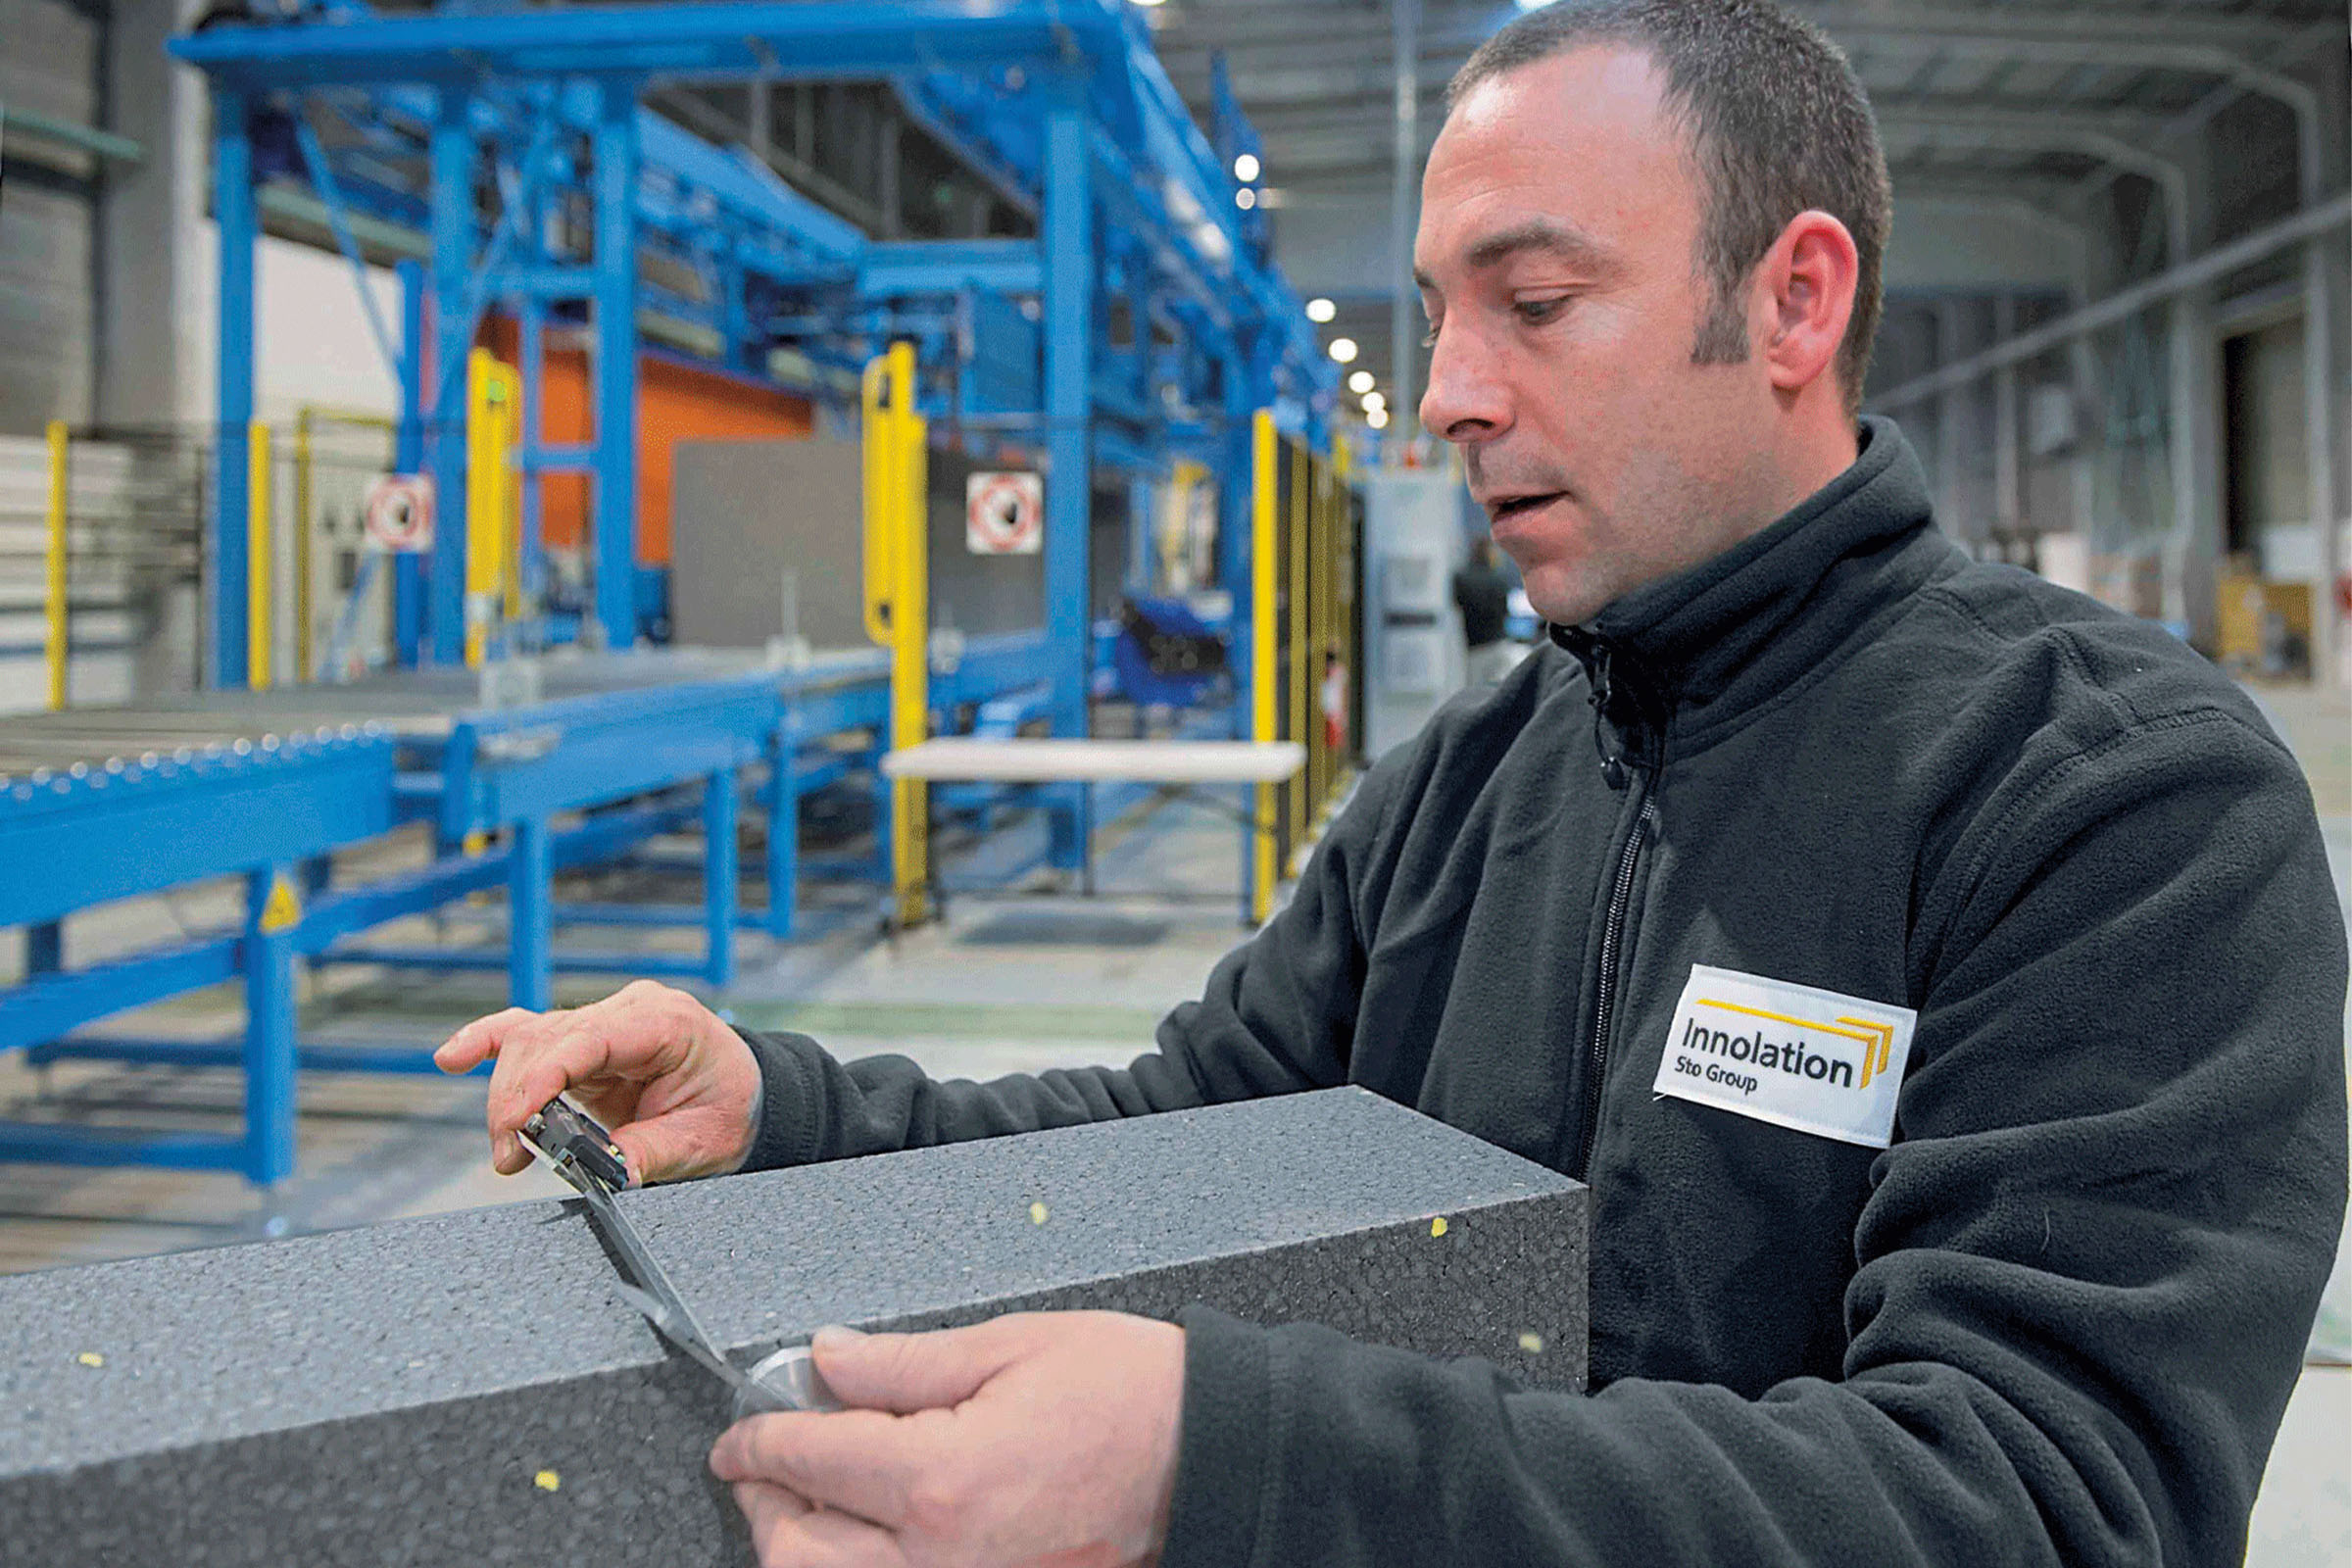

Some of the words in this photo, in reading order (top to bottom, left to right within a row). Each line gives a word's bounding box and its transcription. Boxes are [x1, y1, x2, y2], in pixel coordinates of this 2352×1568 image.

[1674, 1055, 1702, 1078] Sto
[1705, 1063, 1758, 1096] Group
[1682, 1017, 1853, 1088] Innolation
